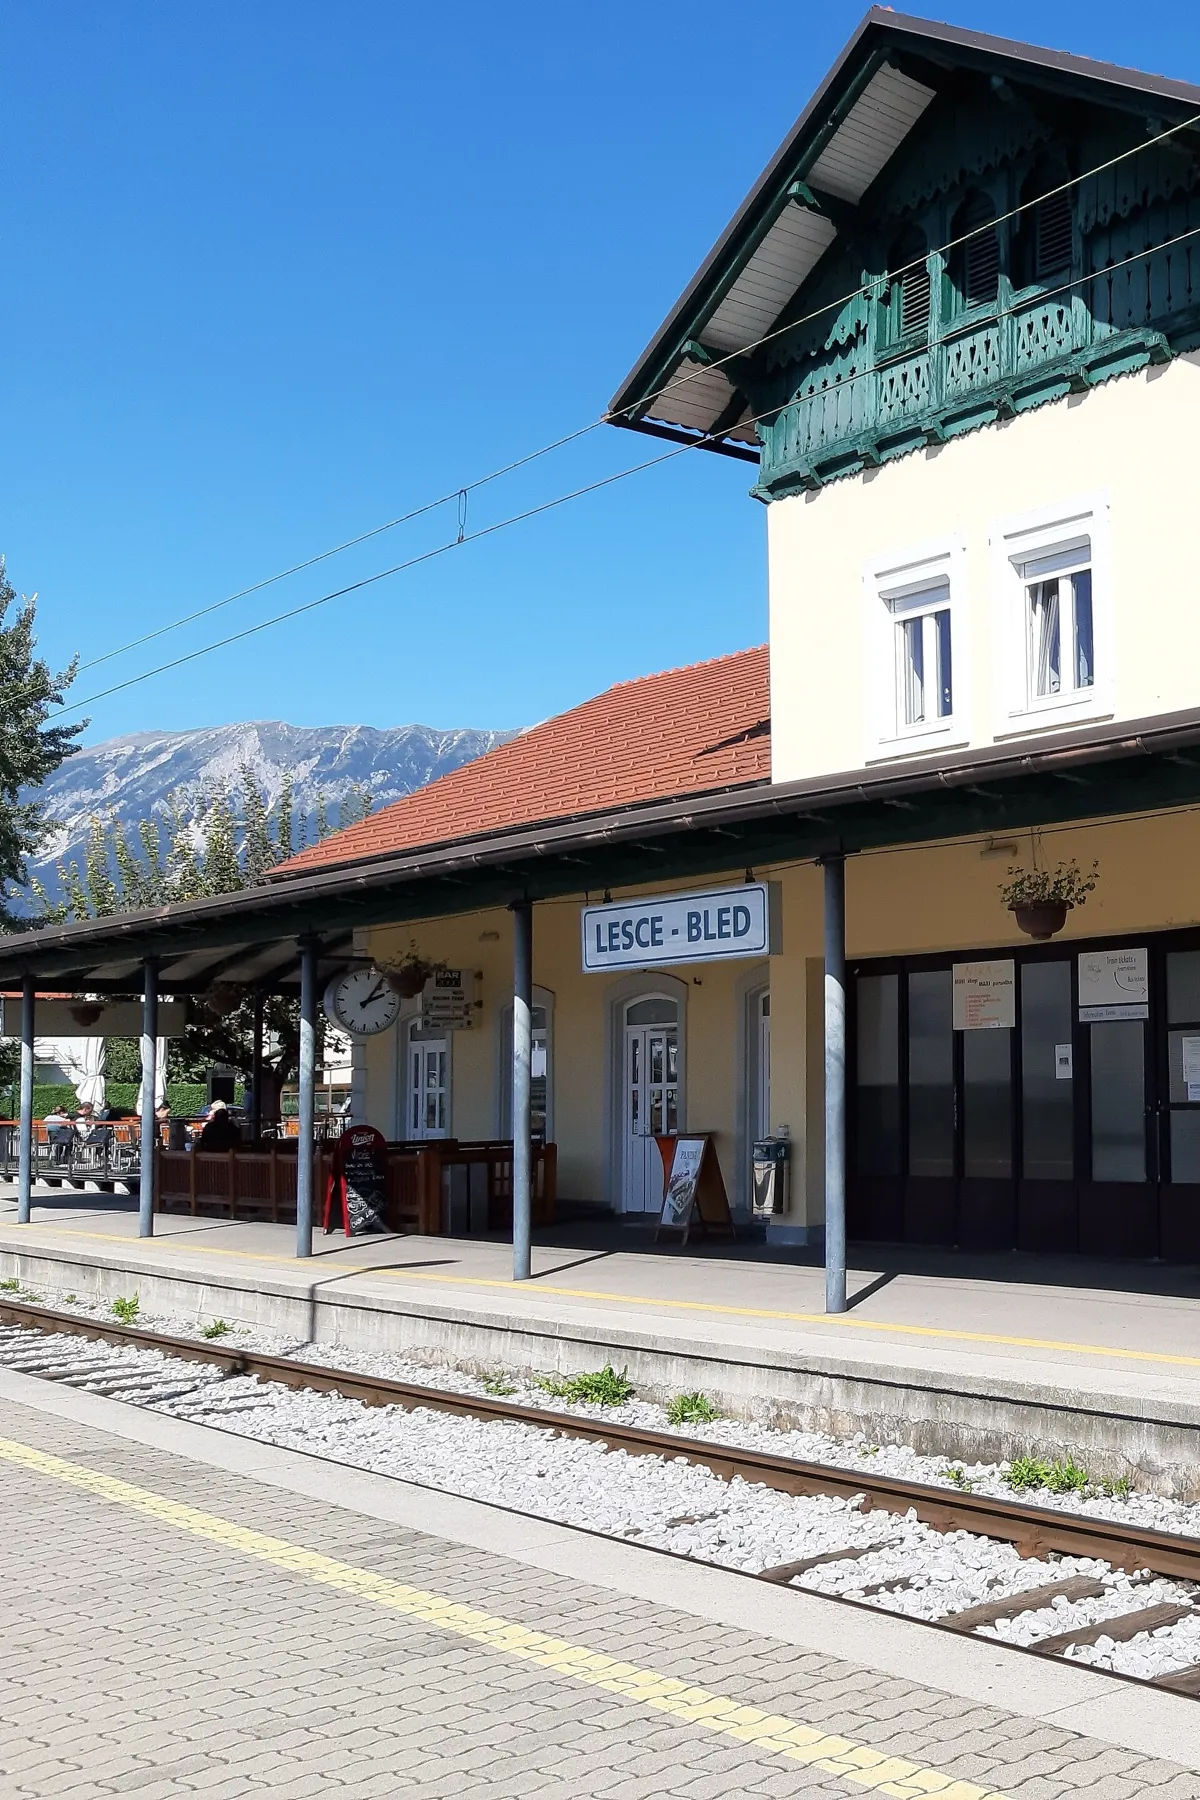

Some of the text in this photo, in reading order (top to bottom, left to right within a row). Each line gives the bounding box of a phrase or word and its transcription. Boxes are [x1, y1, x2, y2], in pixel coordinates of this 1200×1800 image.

[596, 916, 664, 953] LESCE
[687, 905, 751, 943] BLED
[1106, 956, 1118, 965] Train
[437, 971, 460, 979] BAR
[351, 1132, 375, 1145] Union
